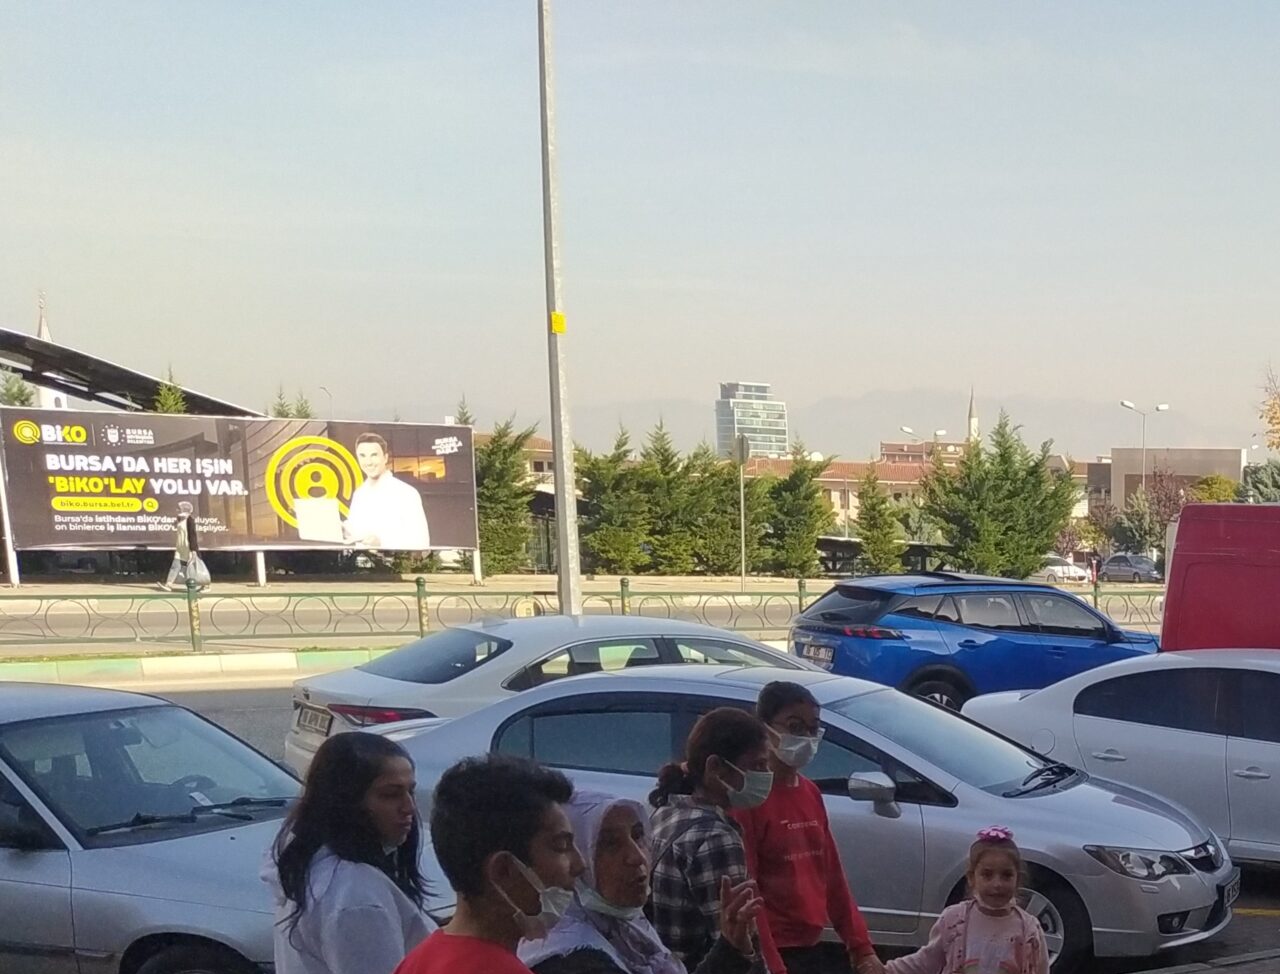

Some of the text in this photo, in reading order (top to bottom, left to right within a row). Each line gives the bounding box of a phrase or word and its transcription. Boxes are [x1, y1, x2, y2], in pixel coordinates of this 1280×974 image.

[45, 454, 150, 473] BURSA'DA
[153, 457, 192, 474] HER
[150, 478, 202, 495] YOLU
[205, 479, 249, 495] VAR.
[60, 498, 134, 508] biko.bursa.bel.tr
[54, 514, 94, 523] Bursa'da
[69, 523, 106, 531] binlerce
